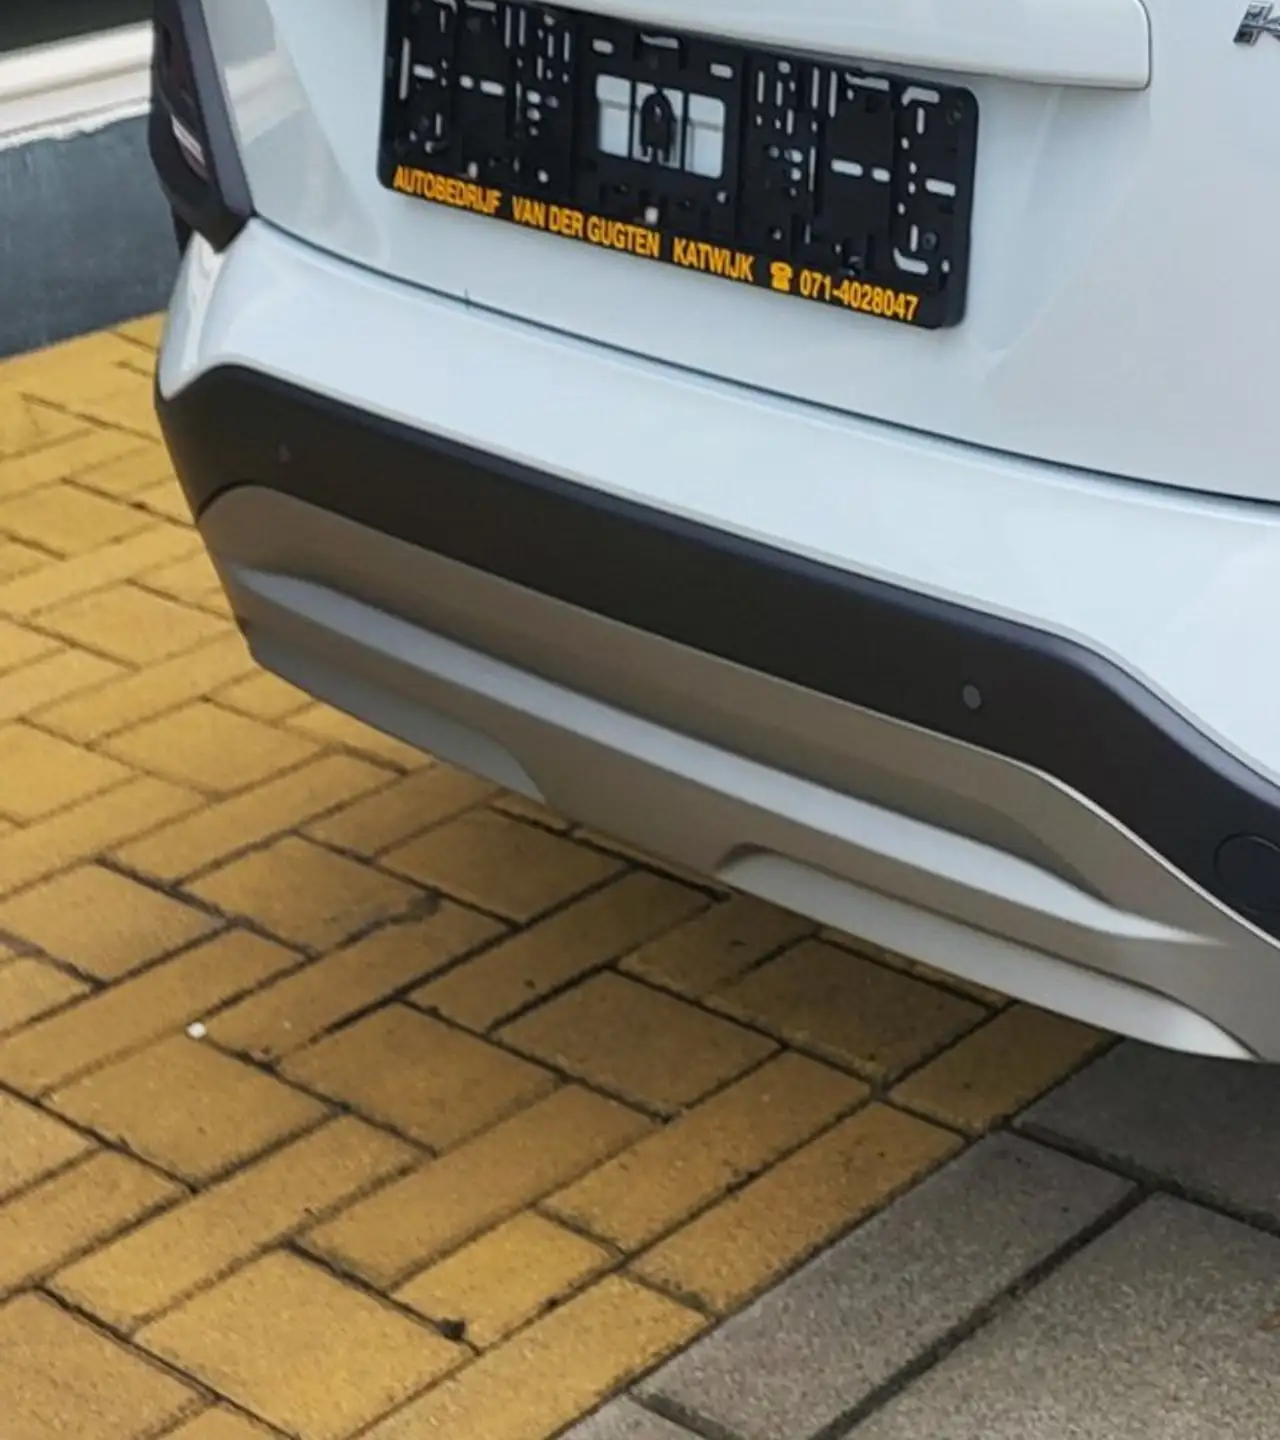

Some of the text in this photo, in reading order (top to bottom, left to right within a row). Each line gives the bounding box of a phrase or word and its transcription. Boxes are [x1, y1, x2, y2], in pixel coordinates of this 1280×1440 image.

[393, 164, 919, 321] AUTOBEDRIJF VAN DER GUGTEN KATWIJK 071-4028047
